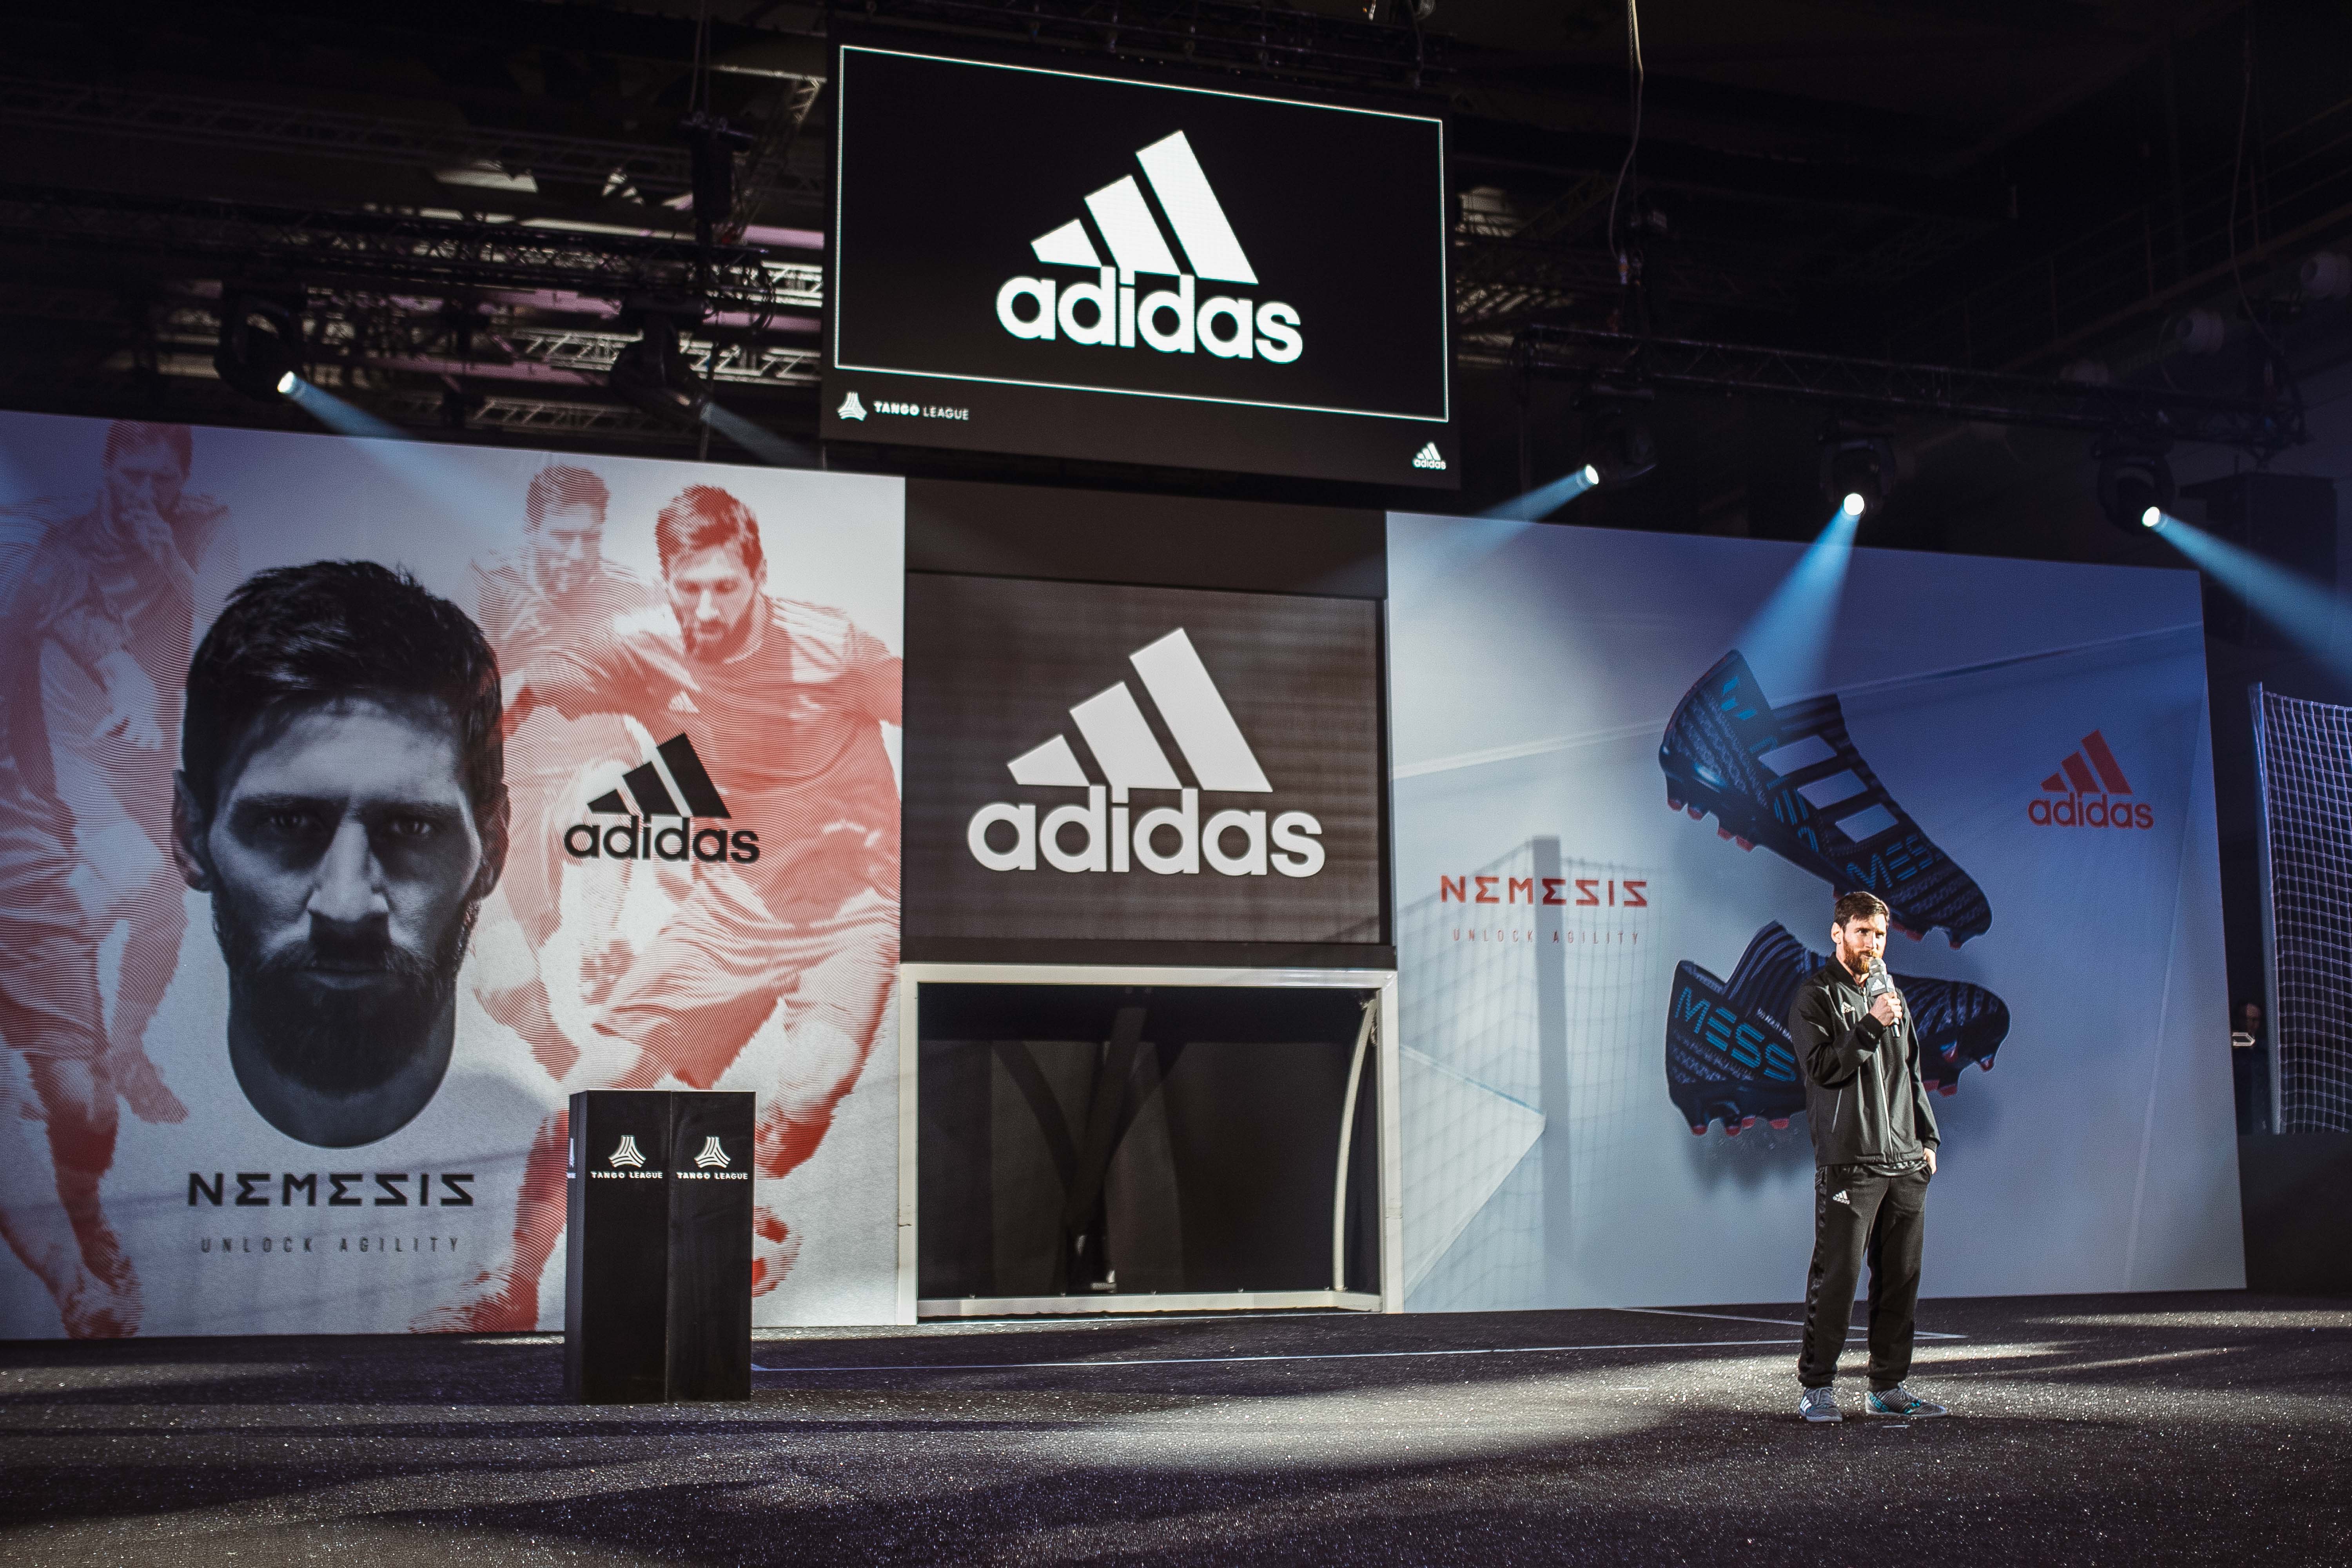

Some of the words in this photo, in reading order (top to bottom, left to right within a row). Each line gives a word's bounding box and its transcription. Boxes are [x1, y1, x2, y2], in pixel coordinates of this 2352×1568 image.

[996, 266, 1303, 363] adidas
[873, 401, 920, 416] TANGO
[923, 406, 969, 421] LEAGUE
[1413, 458, 1446, 470] adidas
[2028, 792, 2154, 830] adidas
[564, 815, 760, 864] adidas
[967, 784, 1325, 877] adidas
[1440, 875, 1647, 907] NEMESIS
[1453, 929, 1533, 942] UNLOCK
[1553, 930, 1638, 945] AGILITY
[188, 1172, 474, 1207] NEMESIS
[201, 1238, 312, 1253] UNLOCK
[340, 1238, 458, 1252] AGILITY
